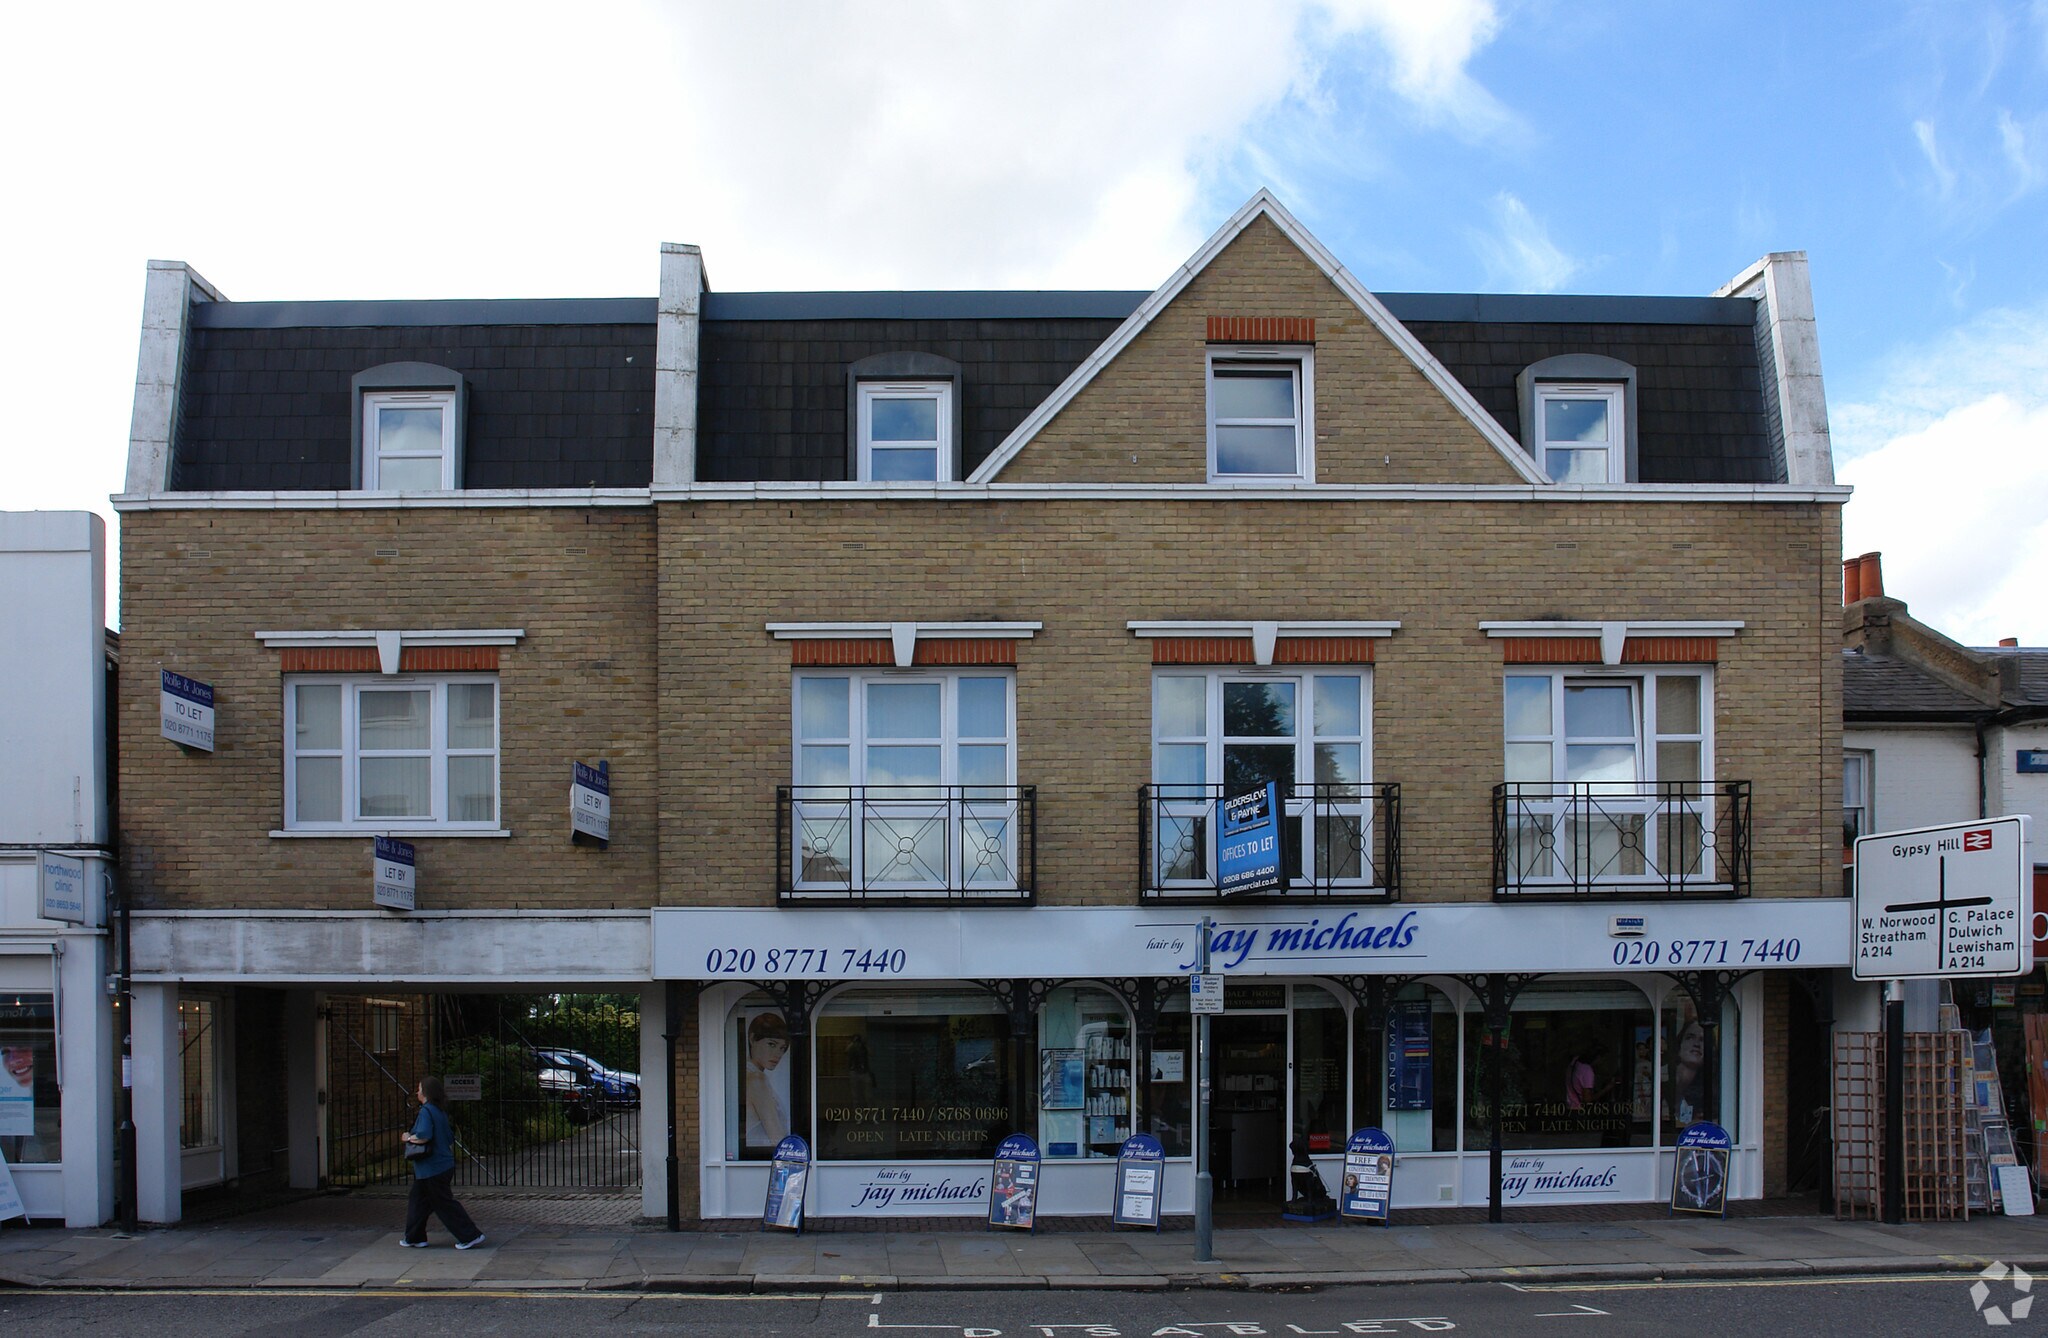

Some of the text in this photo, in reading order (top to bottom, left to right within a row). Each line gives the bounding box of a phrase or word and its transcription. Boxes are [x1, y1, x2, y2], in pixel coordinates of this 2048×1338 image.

[183, 679, 189, 692] &
[192, 682, 211, 700] Jones
[175, 701, 202, 721] TO LET
[164, 719, 212, 743] 020 8771 1175
[583, 793, 602, 809] LET BY
[1230, 804, 1260, 821] & PAYNE
[1222, 836, 1274, 862] OFFICES TO LET
[1892, 838, 1960, 859] Gypsy Hill
[45, 864, 81, 879] northwood
[385, 866, 406, 882] LET BY
[1222, 865, 1275, 884] 0208 686 4400
[55, 880, 72, 892] clinic
[1861, 913, 1936, 930] W. Norwood
[1948, 908, 2015, 924] C. Palace
[1146, 938, 1168, 951] hair
[1170, 939, 1184, 955] by
[1267, 911, 1420, 951] michaels
[1861, 930, 1926, 945] Streatham
[1949, 924, 2003, 939] Dulwich
[1613, 937, 1801, 966] 020 8771 7440
[1949, 940, 2015, 954] Lewisham
[706, 947, 906, 974] 020 8771 7440
[1388, 1004, 1397, 1108] NANOMAX
[825, 1107, 1009, 1124] 020 8771 7440 / 8768 0696
[1534, 1103, 1566, 1117] 7440
[1578, 1102, 1609, 1116] 8768
[1500, 1119, 1626, 1133] PEN LATE NIGHTS
[846, 1130, 989, 1142] OPEN LATE NIGHTS
[1354, 1156, 1373, 1164] FREE
[1510, 1158, 1545, 1173] hair by
[876, 1168, 912, 1183] hair by
[1533, 1165, 1617, 1189] michaels
[851, 1182, 896, 1209] jay
[900, 1177, 985, 1200] michaels
